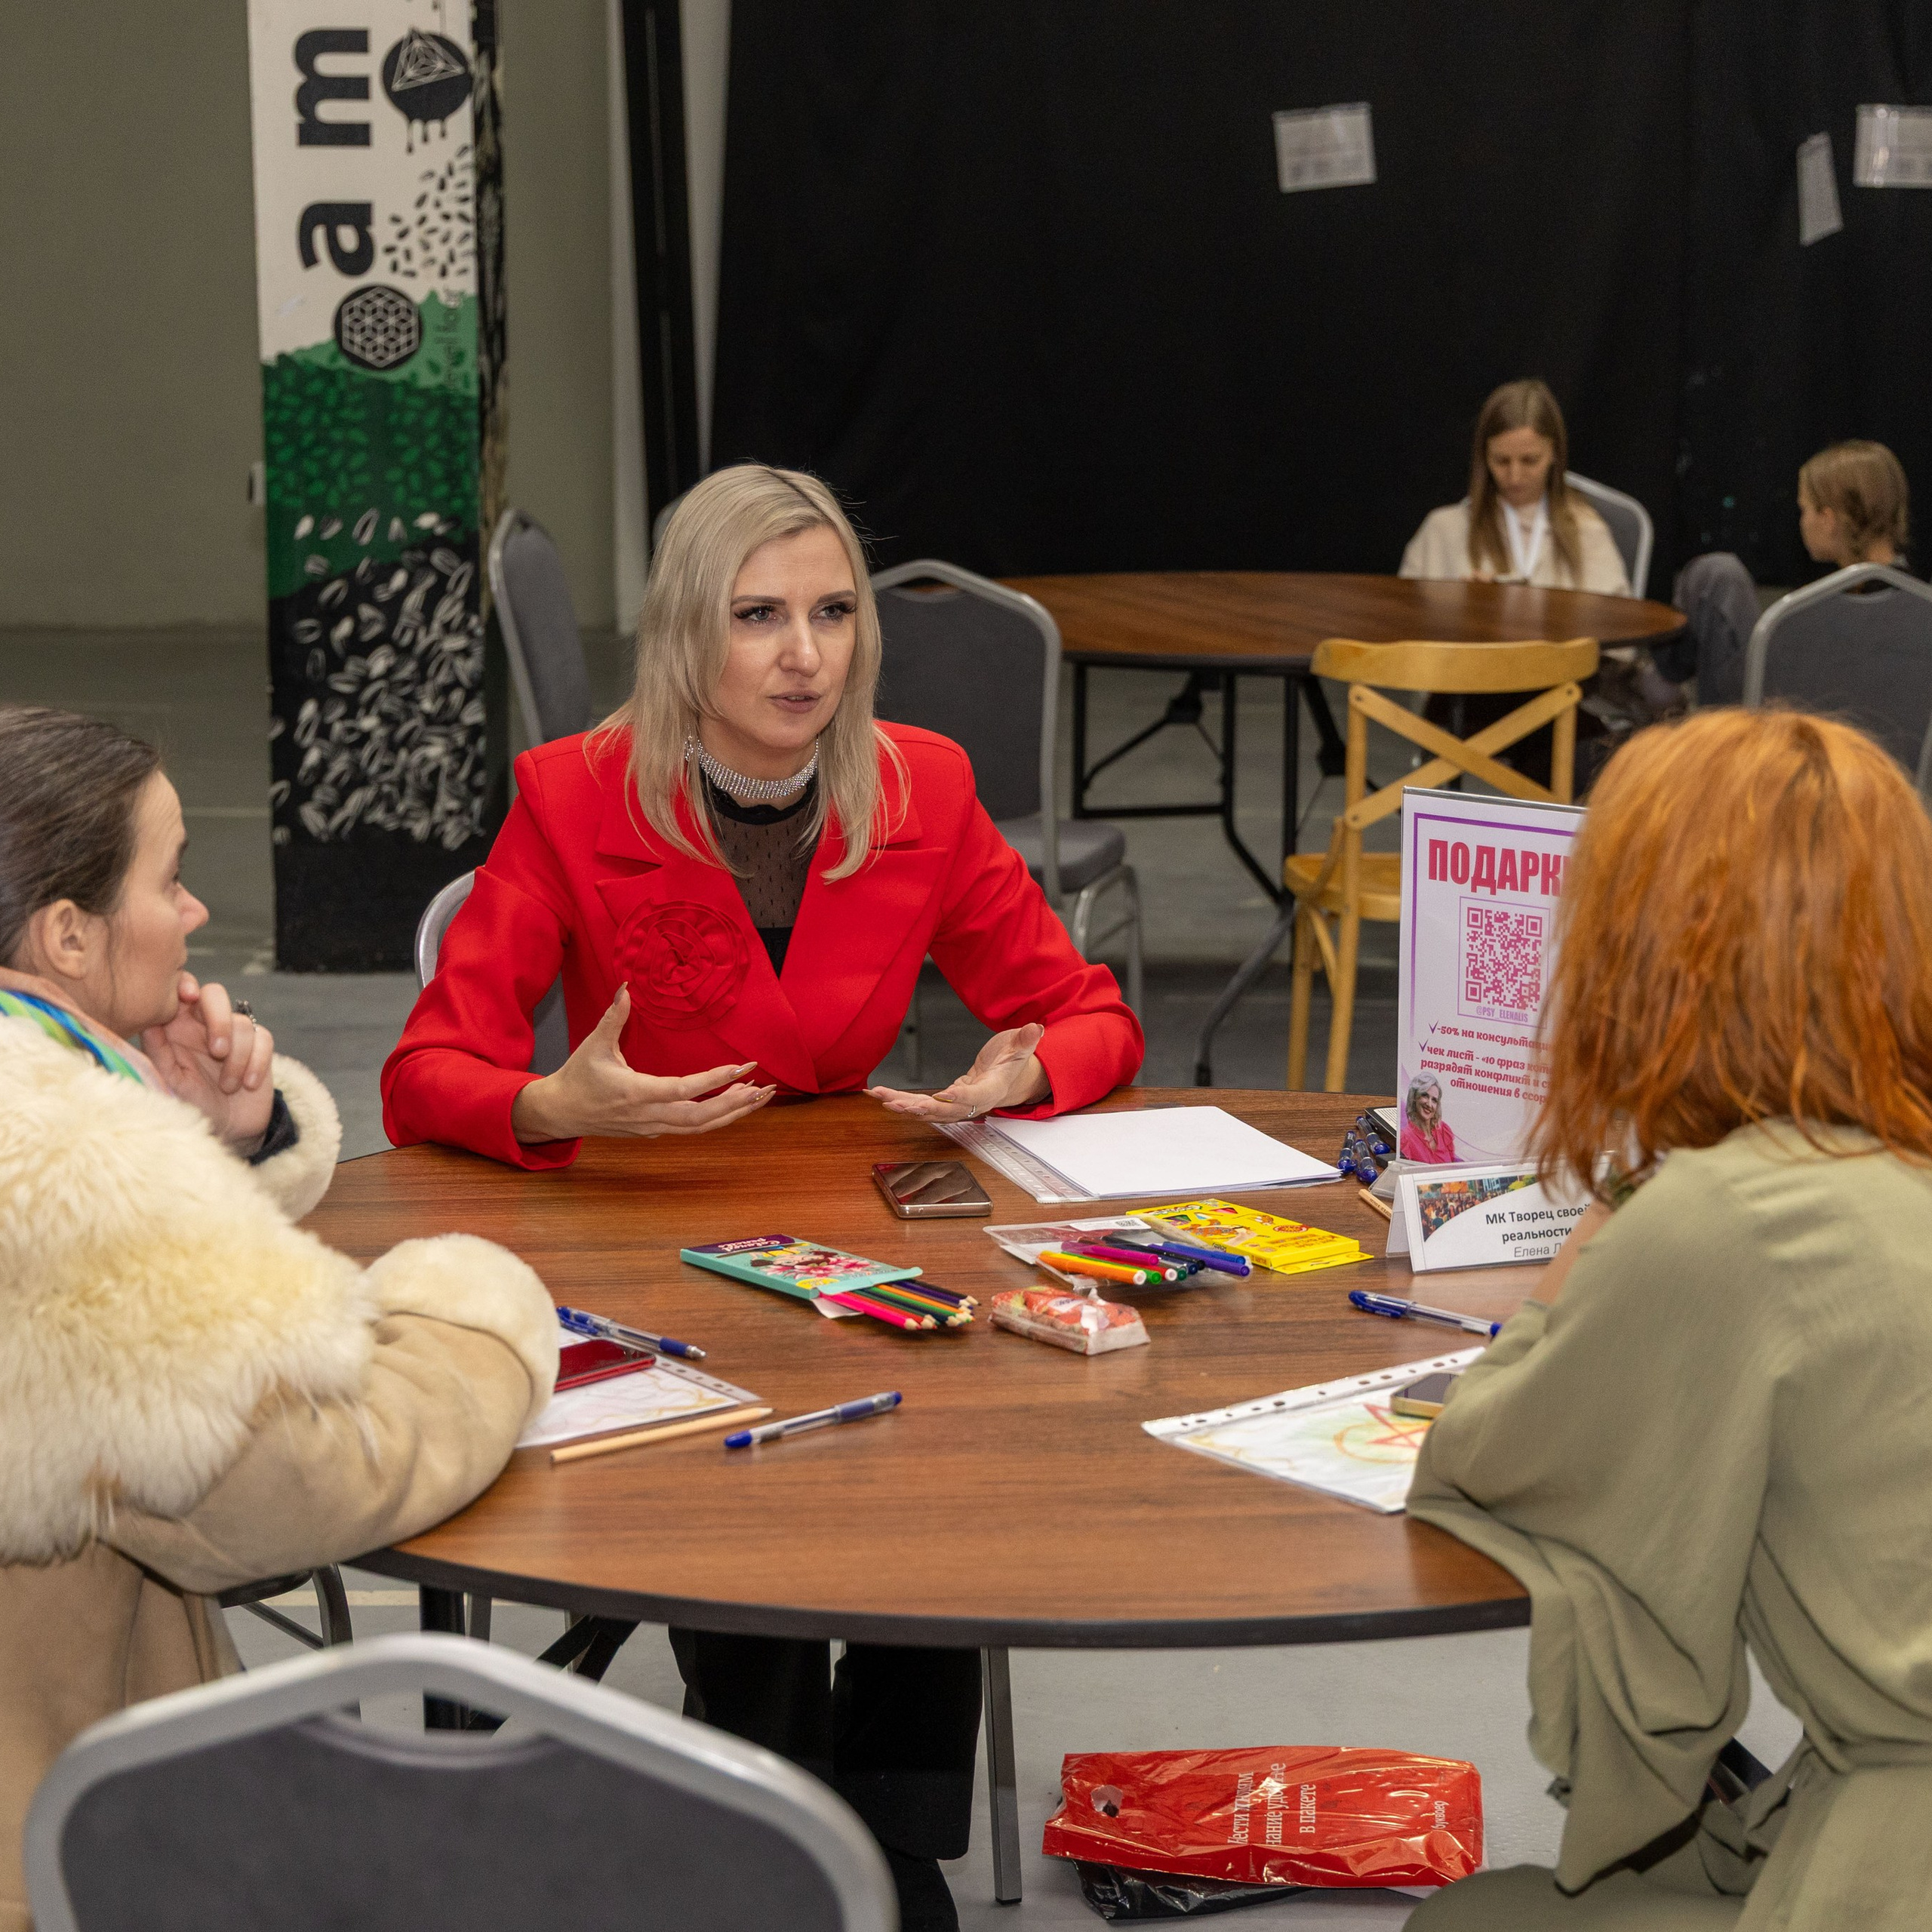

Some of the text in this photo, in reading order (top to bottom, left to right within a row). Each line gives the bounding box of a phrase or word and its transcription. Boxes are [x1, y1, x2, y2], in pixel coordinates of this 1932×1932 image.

[1462, 1029, 1475, 1038] на
[1427, 1046, 1444, 1057] чек
[1447, 1050, 1474, 1061] лист
[1497, 1058, 1525, 1070] фраз
[1420, 1060, 1472, 1075] разрядят
[1475, 1069, 1531, 1086] конфликт
[1451, 1078, 1546, 1105] отношения в ссор
[1486, 1212, 1506, 1225] МК
[1509, 1209, 1555, 1223] Творец
[1502, 1227, 1572, 1244] реальности
[1514, 1246, 1549, 1257] Елена
[1300, 1784, 1316, 1823] пакете
